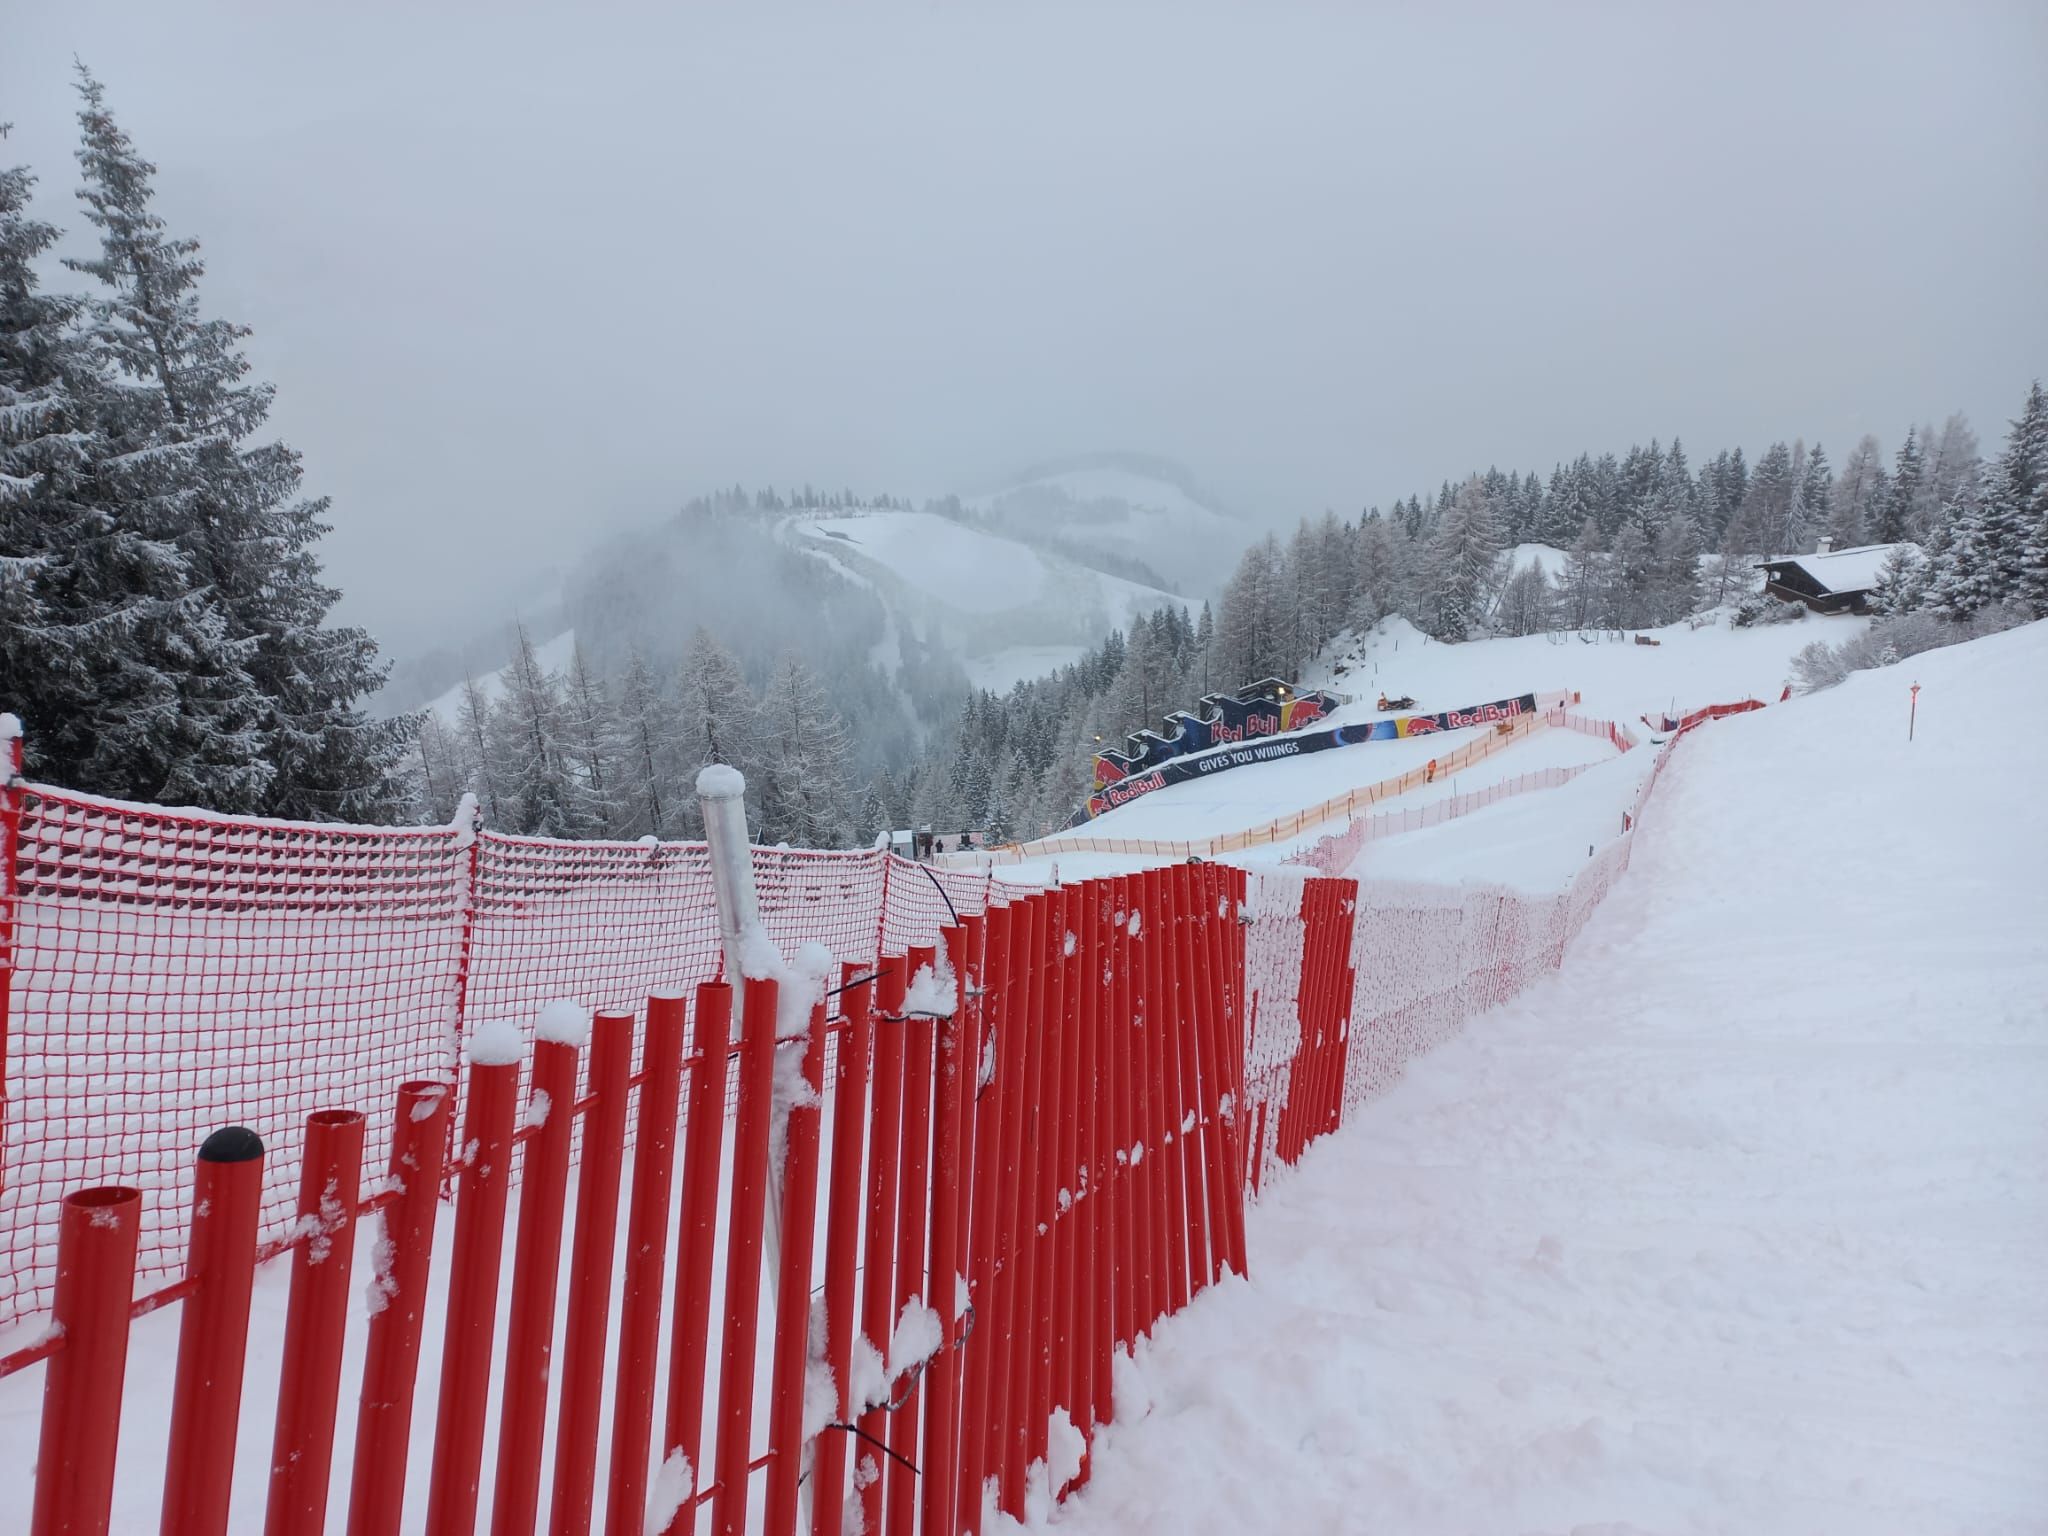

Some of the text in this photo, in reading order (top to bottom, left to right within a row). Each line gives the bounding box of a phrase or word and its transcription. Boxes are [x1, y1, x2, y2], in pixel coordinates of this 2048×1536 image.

[1246, 714, 1278, 736] Bull
[1199, 742, 1300, 772] GIVES YOU WIIINGS
